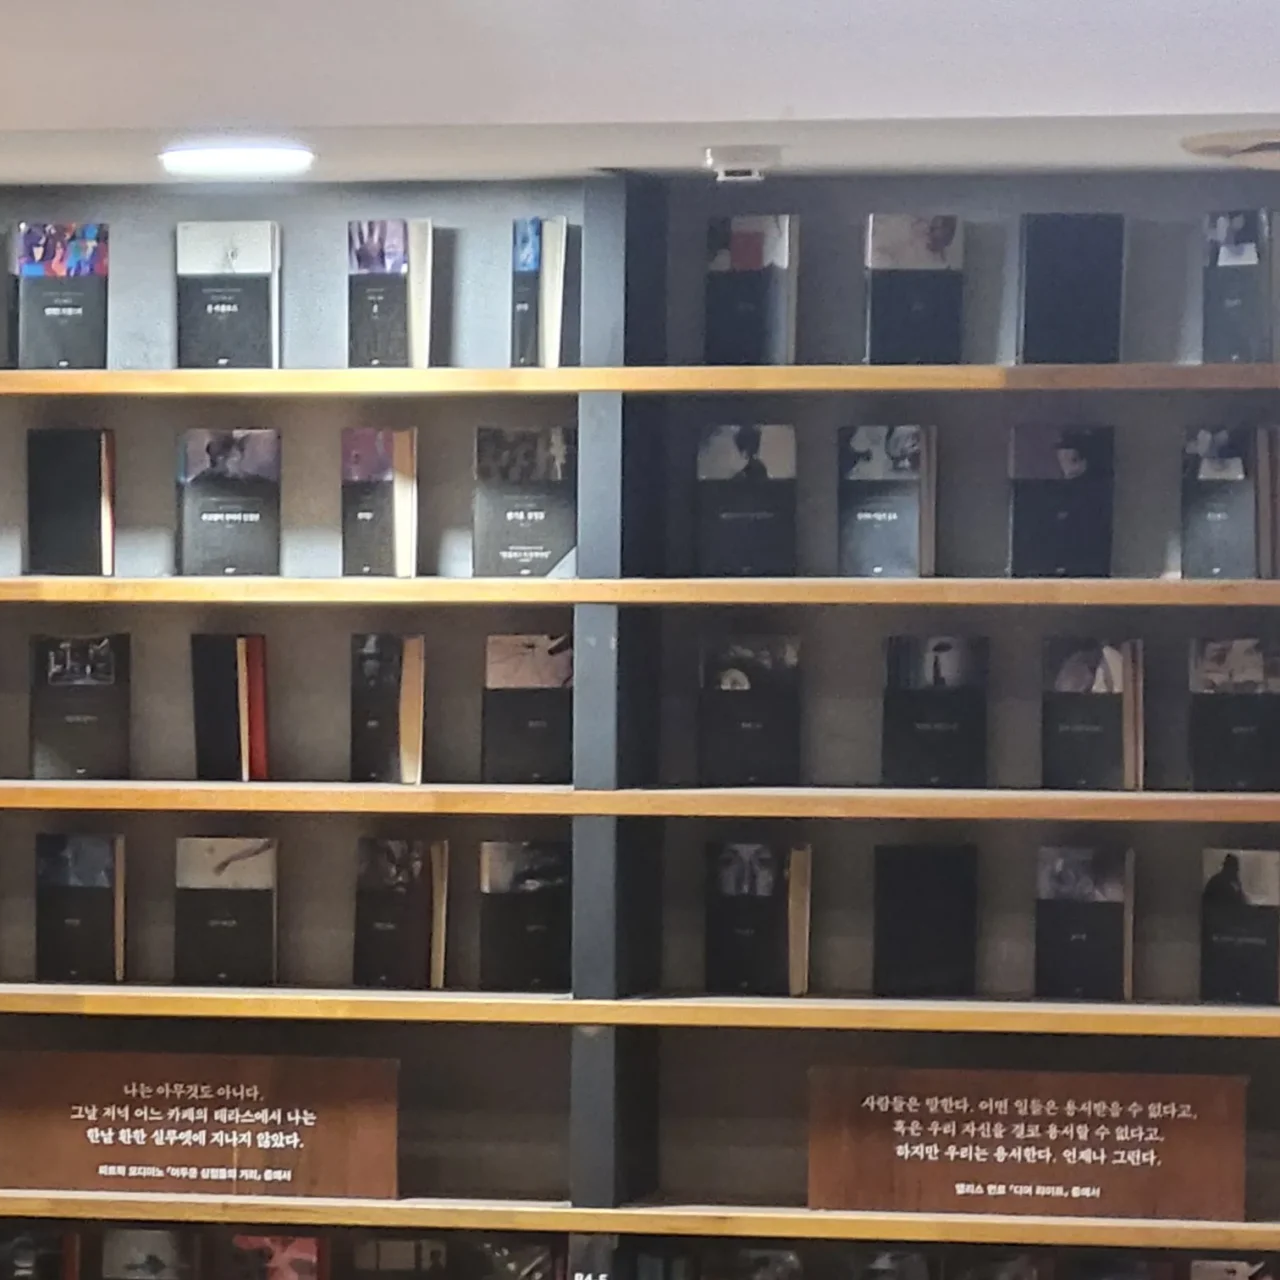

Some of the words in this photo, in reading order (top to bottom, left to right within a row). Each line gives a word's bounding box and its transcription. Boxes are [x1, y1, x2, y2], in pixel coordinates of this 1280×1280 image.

[124, 1082, 153, 1099] 나는
[157, 1083, 214, 1100] 아무것도
[217, 1084, 264, 1101] 아니다.
[71, 1104, 98, 1121] 그날
[102, 1104, 129, 1122] 저녁
[135, 1105, 163, 1121] 어느
[167, 1106, 208, 1123] 카페의
[214, 1107, 281, 1125] 테라스에서
[287, 1108, 317, 1126] 나는
[861, 1095, 920, 1113] 사람들은
[979, 1097, 1008, 1115] 어떤
[1014, 1098, 1058, 1116] 일들은
[1064, 1098, 1122, 1118] 용서받을
[1128, 1101, 1143, 1119] 수
[151, 1129, 206, 1147] 실루엣에
[210, 1130, 251, 1148] 지나지
[257, 1131, 304, 1149] 않았다.
[893, 1120, 923, 1137] 혹은
[927, 1120, 956, 1137] 우리
[961, 1121, 1006, 1139] 자신을
[1046, 1123, 1089, 1141] 용서할
[1094, 1124, 1110, 1141] 수
[896, 1142, 939, 1161] 하지만
[944, 1144, 988, 1162] 우리는
[993, 1145, 1056, 1164] 용서한다.
[1062, 1147, 1106, 1166] 언제나
